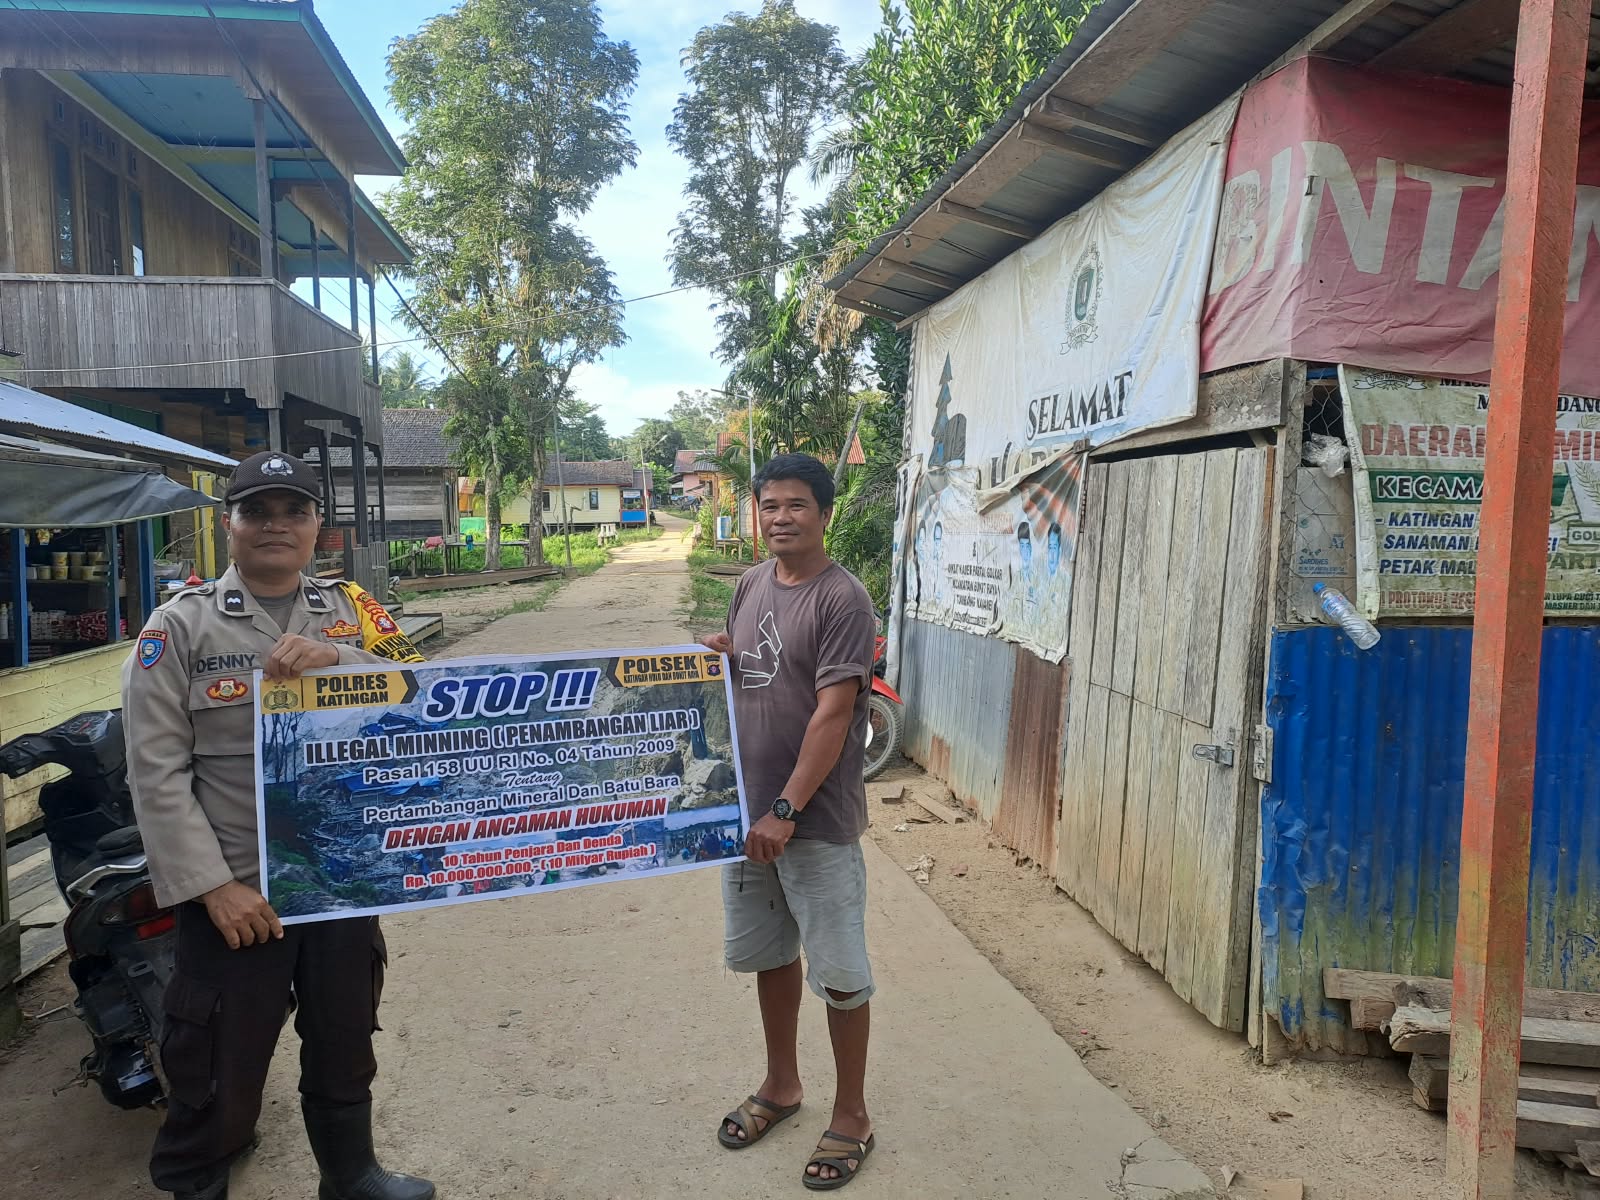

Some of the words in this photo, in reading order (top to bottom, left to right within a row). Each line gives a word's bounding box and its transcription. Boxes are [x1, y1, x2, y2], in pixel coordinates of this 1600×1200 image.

[1026, 371, 1133, 441] SELAMAT
[1388, 512, 1474, 528] KATINGAN
[1384, 535, 1469, 550] SANAMAN
[1380, 560, 1435, 574] PETAK
[1440, 560, 1476, 575] MAL
[196, 654, 255, 673] DENNY
[623, 655, 698, 674] POLSEK
[316, 674, 387, 693] POLRES
[624, 673, 649, 683] KATINGAN
[649, 672, 661, 681] HULU
[662, 672, 672, 681] DAN
[673, 671, 687, 680] BUKIT
[317, 691, 388, 707] KATINGAN
[426, 674, 546, 718] STOP
[306, 737, 391, 764] ILLEGAL
[395, 728, 489, 756] MINNING
[365, 763, 420, 782] Pasal
[425, 761, 459, 776] 158
[465, 758, 492, 772] UU
[499, 755, 517, 768] RI
[523, 752, 552, 766] No.
[557, 749, 578, 763] 04
[582, 744, 633, 759] Tahun
[637, 739, 674, 754] 2009
[503, 772, 561, 787] Tentang
[366, 798, 496, 822] Pertambangan
[503, 787, 562, 806] Mineral
[569, 785, 599, 798] Dan
[604, 779, 640, 794] Batu
[645, 776, 679, 789] Bara
[385, 821, 471, 849] DENGAN
[473, 809, 571, 840] ANCAMAN
[575, 798, 666, 826] HUKUMAN
[443, 855, 458, 867] 10
[462, 851, 501, 865] Tahun
[505, 843, 554, 859] Penjara
[557, 840, 580, 852] Dan
[583, 835, 622, 848] Denda
[405, 876, 426, 888] Rp.
[549, 857, 562, 868] 10
[566, 852, 604, 867] Milyar
[607, 845, 648, 861] Rupiah
